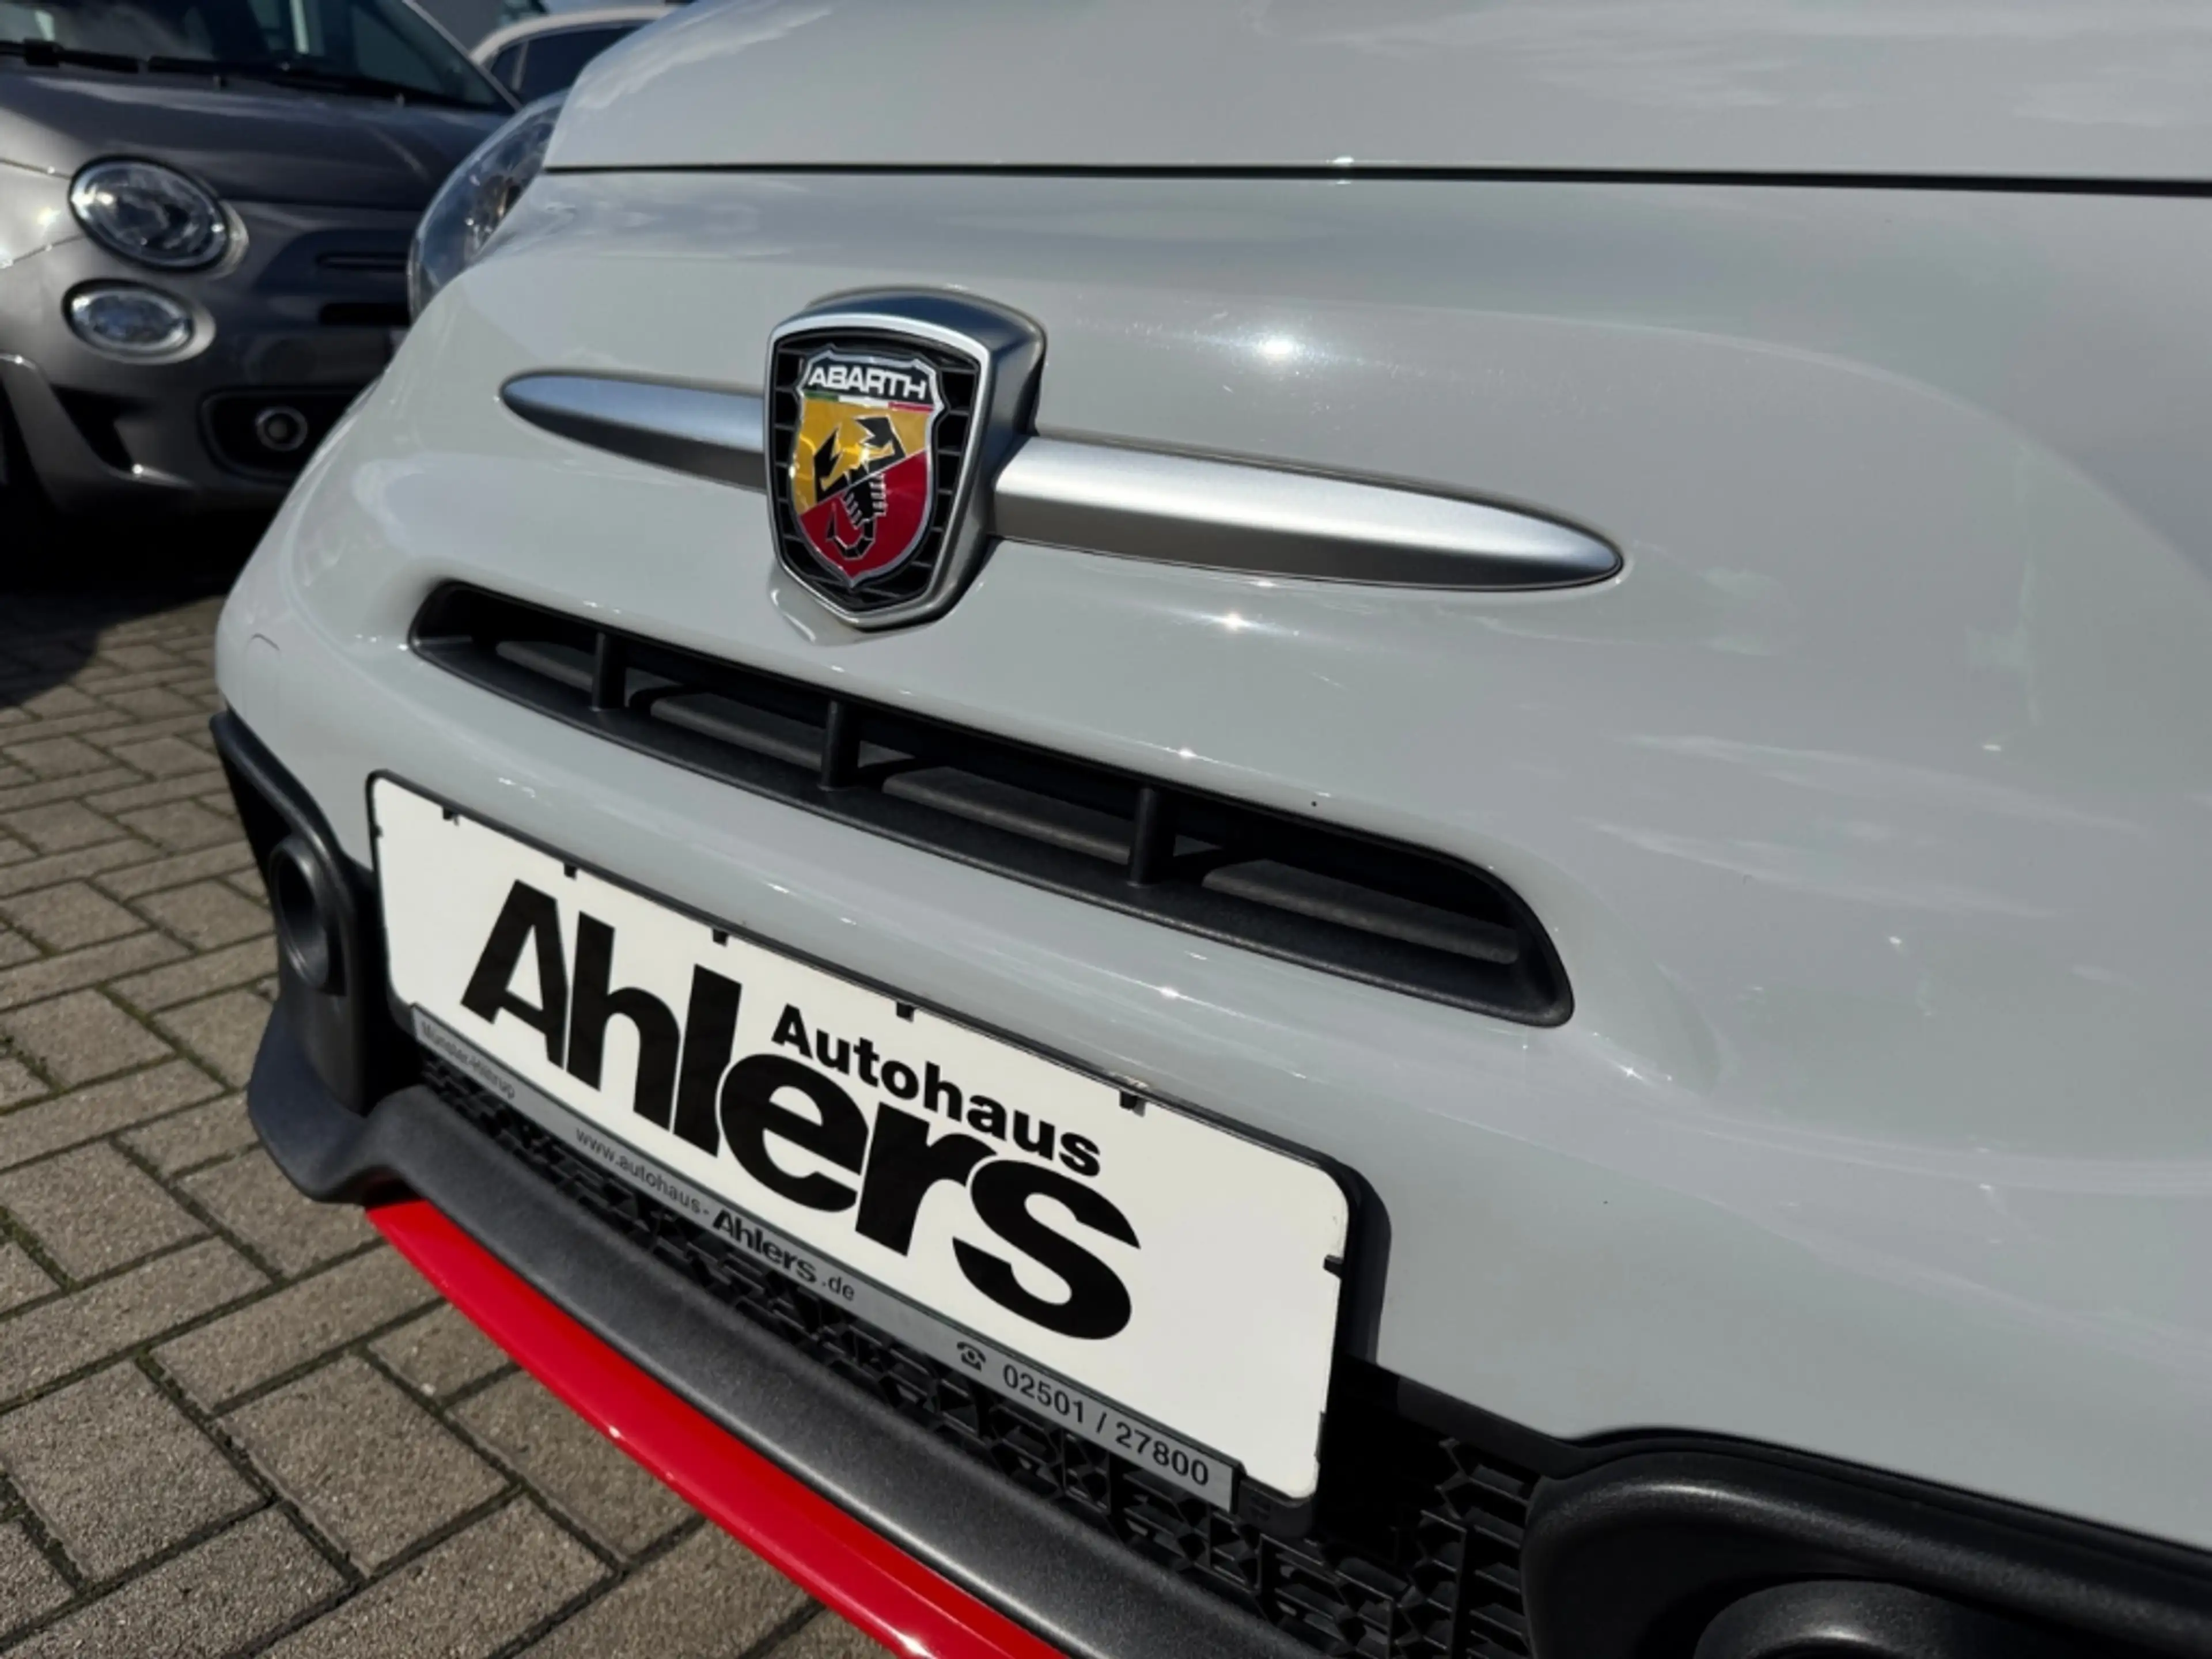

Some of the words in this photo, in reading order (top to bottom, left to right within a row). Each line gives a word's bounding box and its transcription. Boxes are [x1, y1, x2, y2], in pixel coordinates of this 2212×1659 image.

[808, 366, 926, 400] ABARTH
[460, 879, 1141, 1340] Ahlers
[771, 1004, 1101, 1178] Autohaus
[1002, 1364, 1084, 1423] 02501
[1096, 1412, 1107, 1433] /
[1116, 1421, 1209, 1486] 27800
